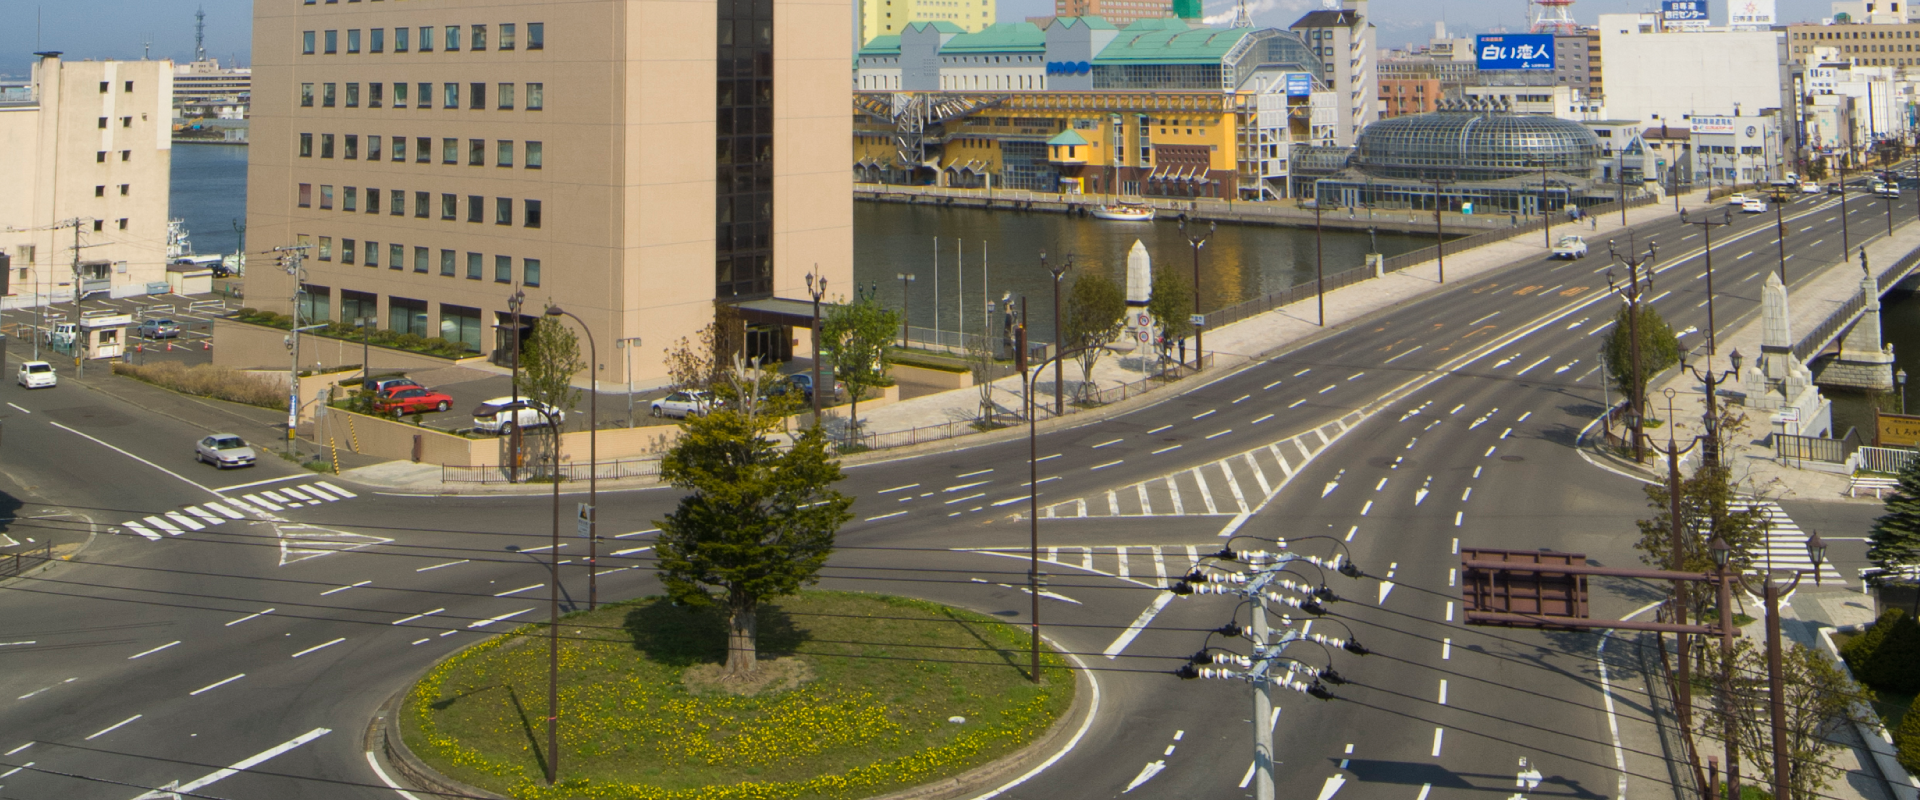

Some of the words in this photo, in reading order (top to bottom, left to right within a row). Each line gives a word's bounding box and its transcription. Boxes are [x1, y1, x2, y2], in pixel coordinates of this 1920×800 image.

[1665, 10, 1705, 19] 旅行センター
[1481, 44, 1550, 60] 白い恋人
